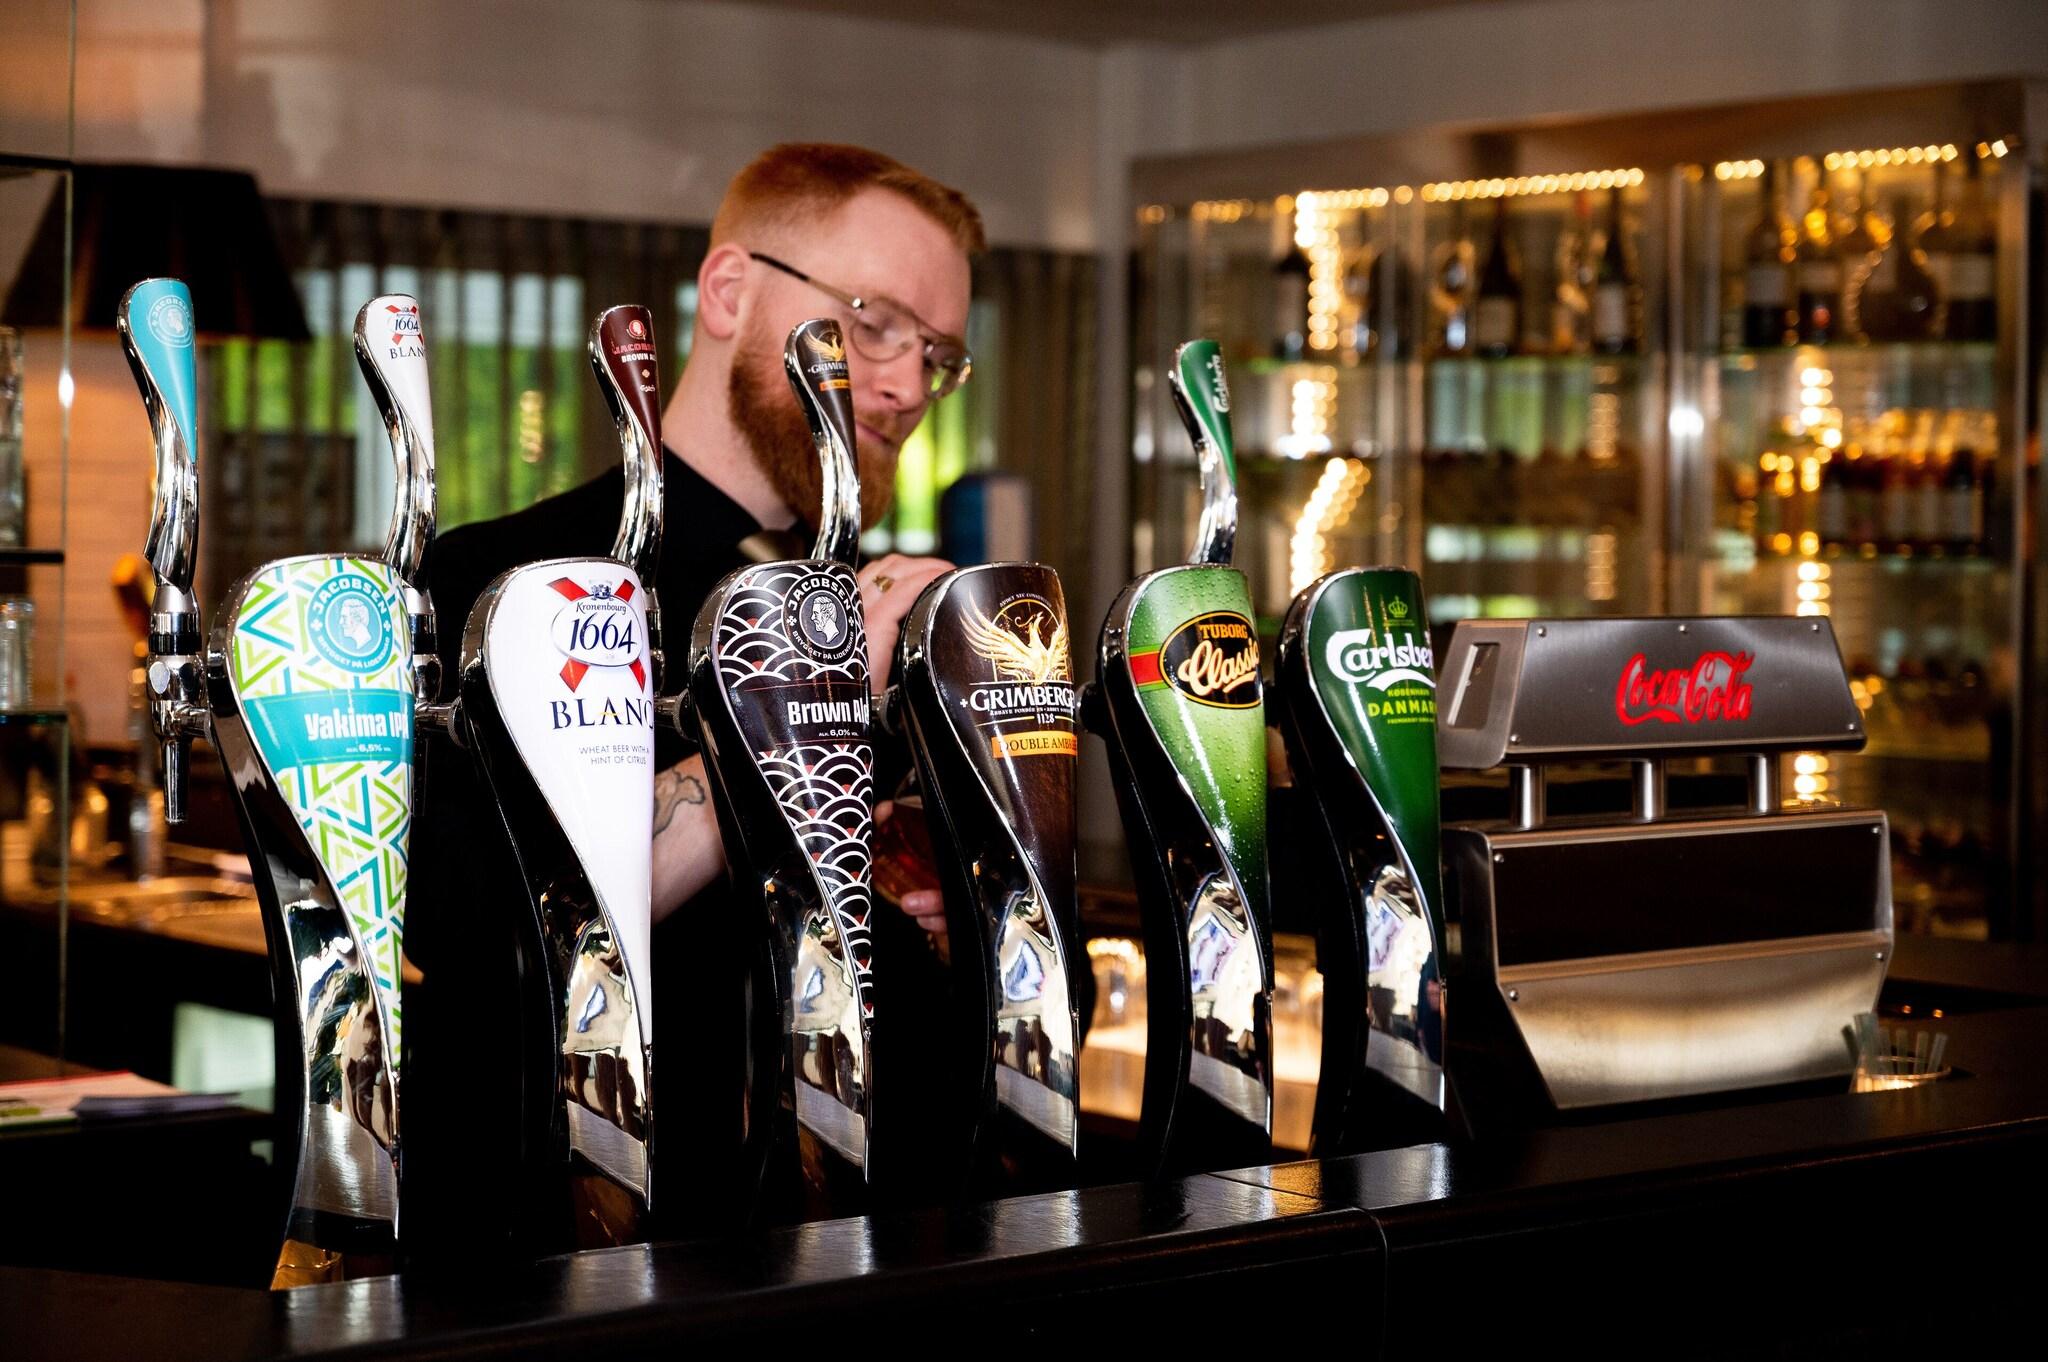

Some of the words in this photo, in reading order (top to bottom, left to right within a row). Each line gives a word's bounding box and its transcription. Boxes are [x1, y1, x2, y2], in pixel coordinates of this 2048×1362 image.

[394, 316, 420, 332] 1664
[390, 346, 424, 360] BLAN
[313, 577, 388, 614] JACOBSEN
[788, 577, 852, 611] JACOBSEN
[575, 601, 627, 615] Kronenbourg
[569, 612, 638, 654] 1664
[1200, 623, 1248, 639] TUBORG
[793, 630, 823, 658] BRYGGET
[1177, 637, 1260, 696] Classic
[1616, 652, 1756, 727] Coca-Cola
[787, 701, 852, 726] Brown
[1036, 713, 1055, 725] 1128
[829, 729, 851, 738] 6,0%
[579, 745, 610, 754] WHEAT
[612, 744, 630, 753] BEER
[999, 738, 1050, 753] DOUBLE
[591, 756, 611, 765] HINT
[614, 755, 625, 764] OF
